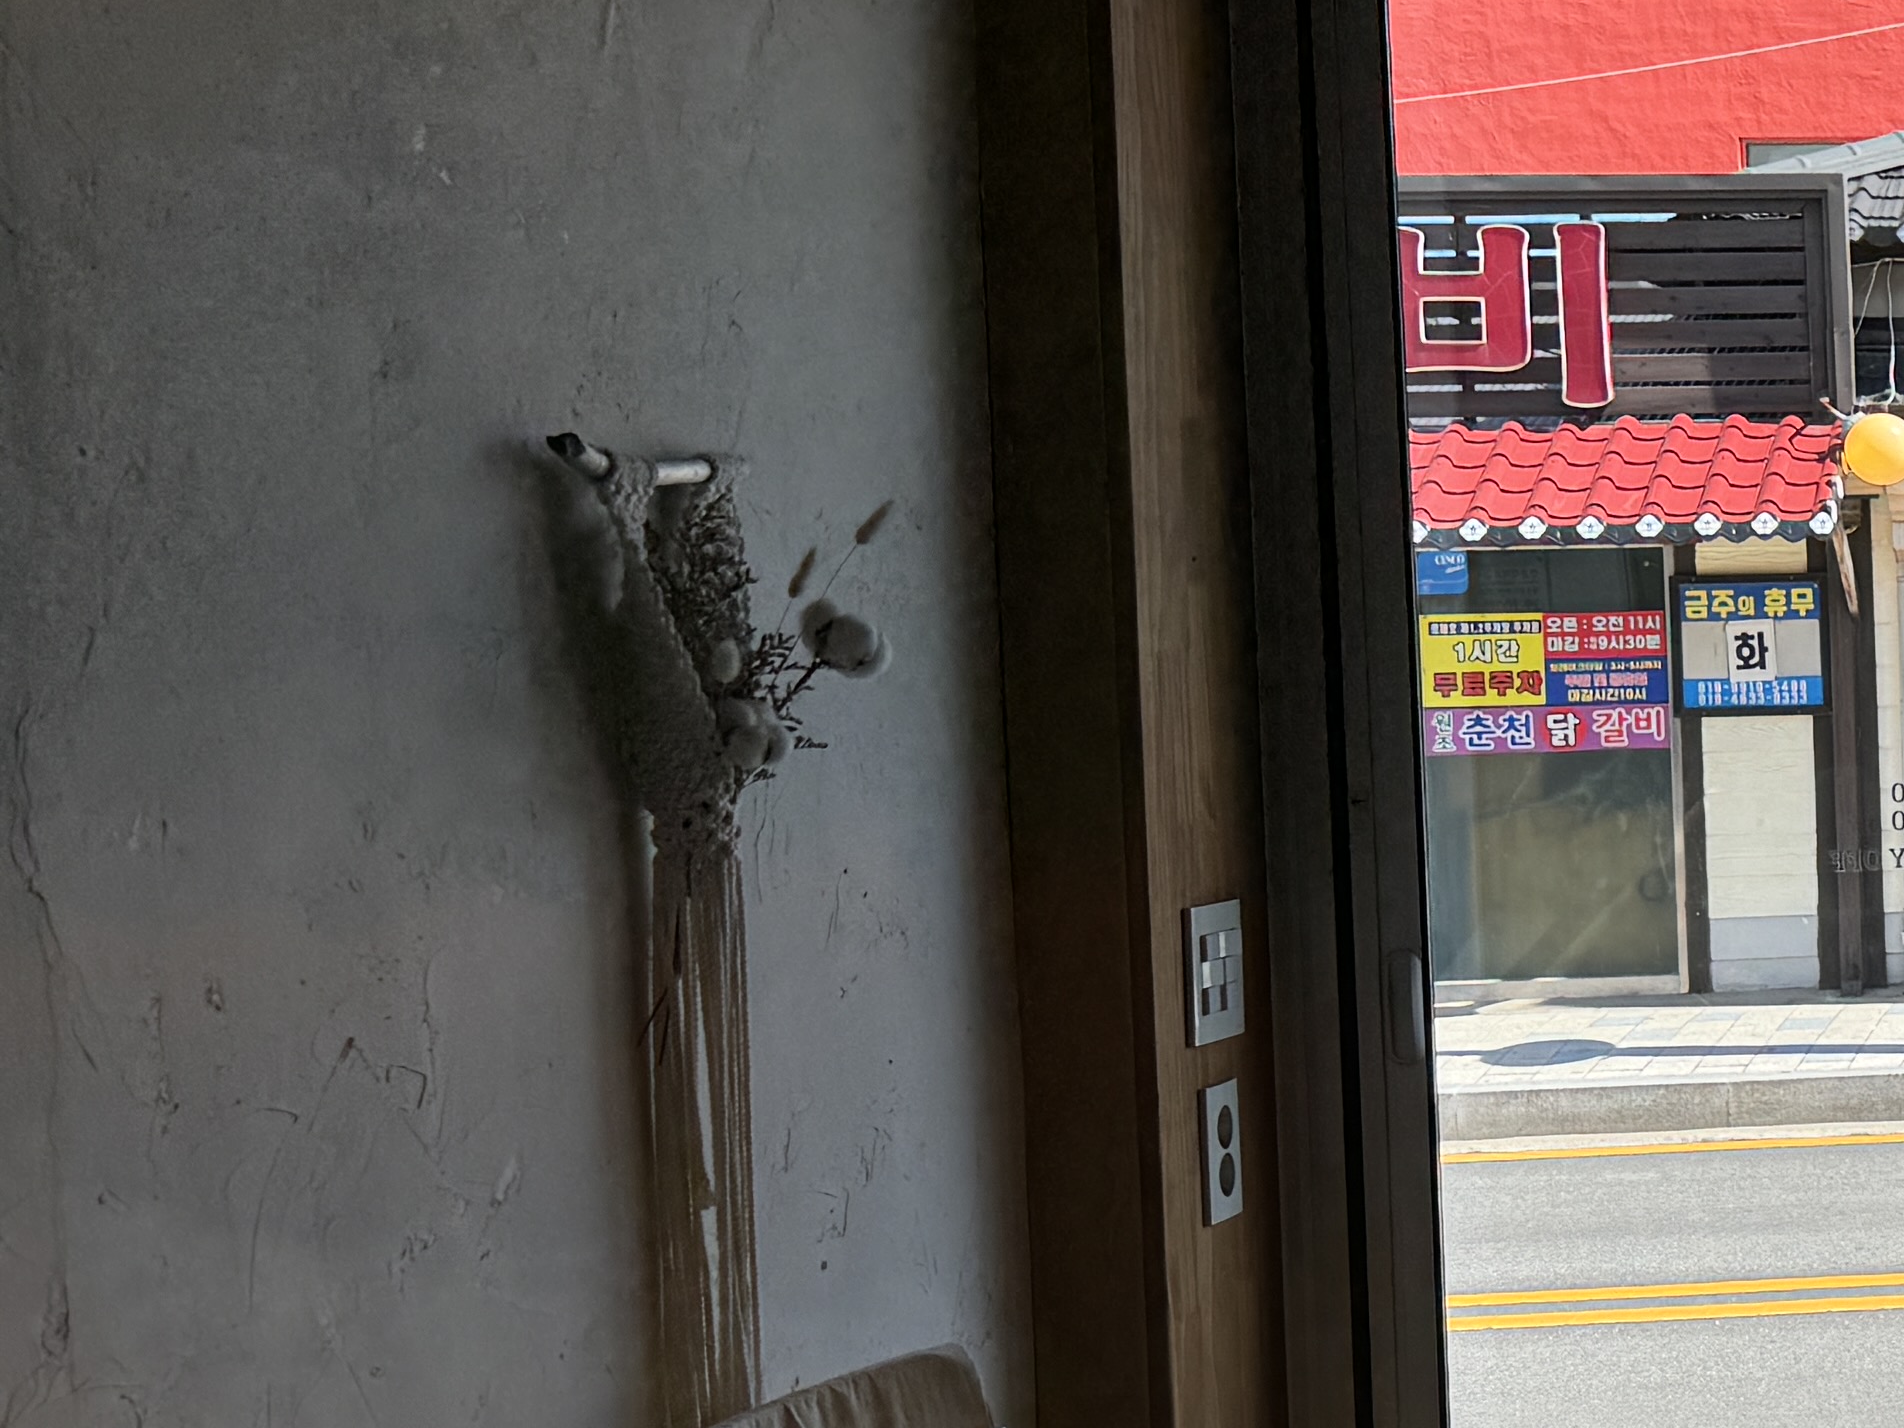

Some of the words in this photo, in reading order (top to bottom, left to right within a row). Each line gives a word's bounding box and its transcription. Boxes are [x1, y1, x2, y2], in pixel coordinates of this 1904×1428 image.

[1684, 589, 1756, 619] 금주의
[1764, 587, 1815, 618] 휴무
[1592, 616, 1624, 632] 오전
[1628, 615, 1661, 630] 11시
[1453, 639, 1520, 664] 1시간
[1733, 631, 1769, 671] 화
[1433, 670, 1544, 698] 무료주차
[1459, 710, 1536, 752] 춘천
[1546, 711, 1582, 748] 닭
[1592, 706, 1666, 748] 갈비
